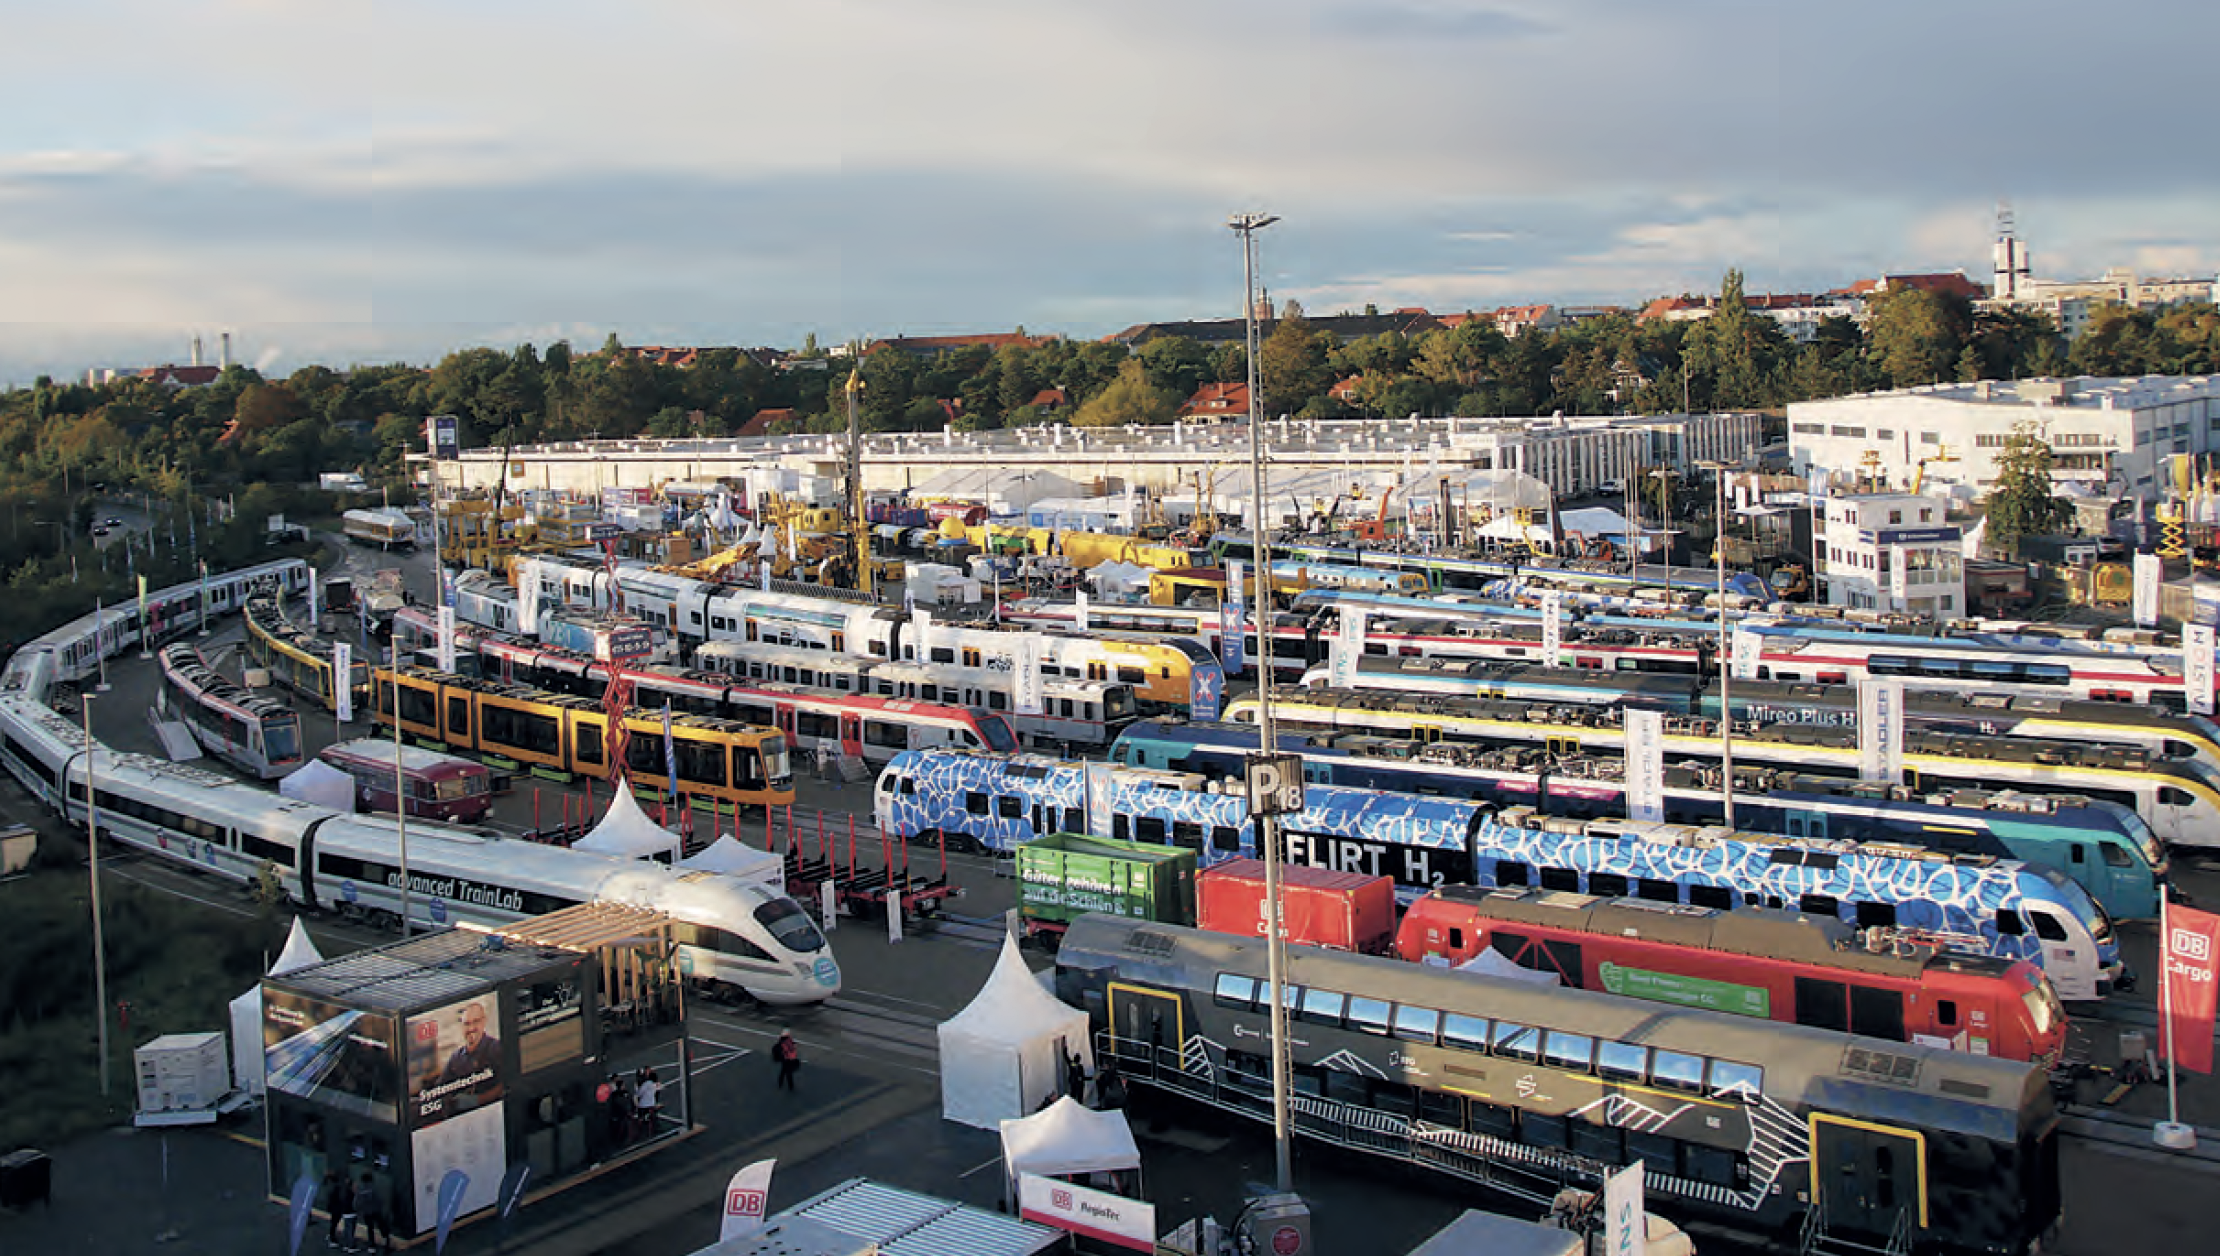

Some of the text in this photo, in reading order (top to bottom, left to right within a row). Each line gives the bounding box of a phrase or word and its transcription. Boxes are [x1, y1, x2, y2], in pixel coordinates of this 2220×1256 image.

[1747, 704, 1797, 724] Mireo
[1801, 708, 1837, 725] Plus
[1287, 834, 1386, 876] FLIRT
[458, 879, 523, 911] TrainLab
[1022, 868, 1122, 896] Güter gehören
[2175, 931, 2207, 957] DB
[420, 1067, 494, 1102] Systemtechnik
[420, 1099, 443, 1116] ESG
[731, 1192, 762, 1213] DB
[1053, 1190, 1071, 1209] DB
